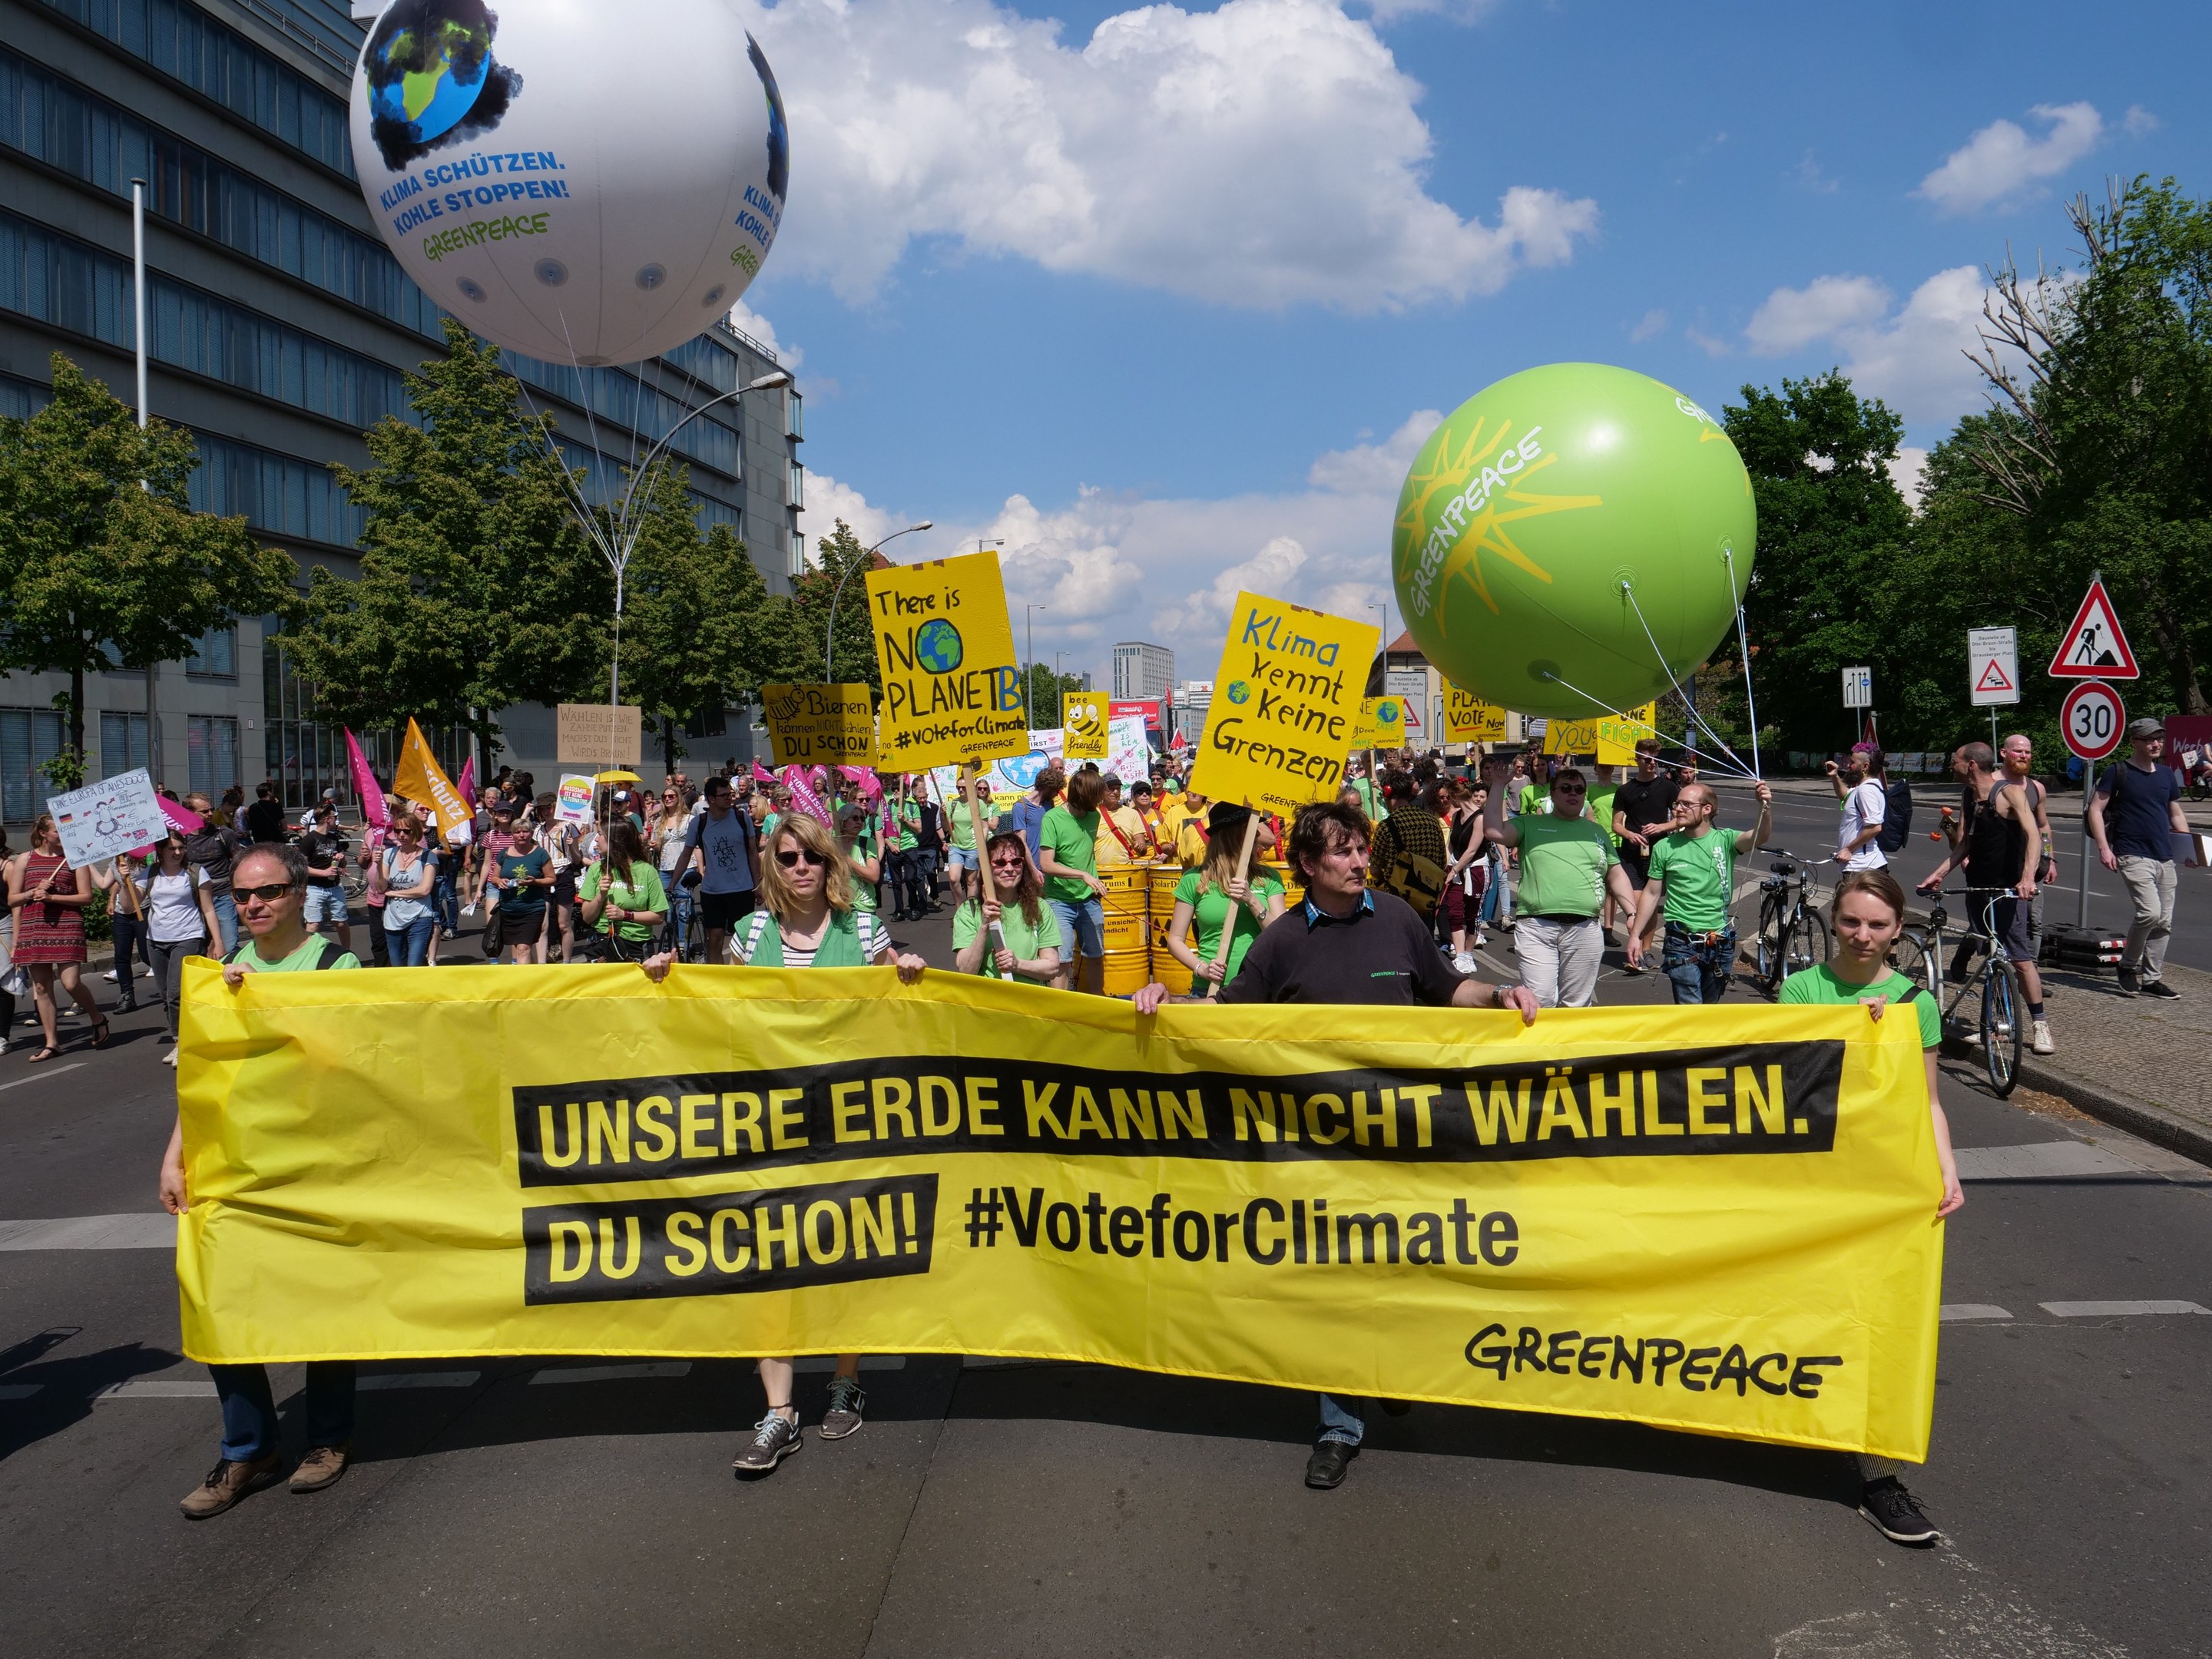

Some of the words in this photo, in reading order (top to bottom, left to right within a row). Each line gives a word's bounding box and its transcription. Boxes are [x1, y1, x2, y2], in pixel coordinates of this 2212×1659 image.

[379, 175, 423, 213] KLIMA
[423, 151, 566, 188] SCHÜTZEN.
[392, 198, 443, 237] KOHLE
[444, 180, 571, 213] STOPPEN!
[743, 184, 775, 221] KLIMA
[423, 212, 551, 263] GREENPEACE
[735, 210, 770, 247] KOHLE
[1410, 426, 1543, 618] GREENPEACE
[875, 590, 935, 615] There
[943, 586, 961, 610] is
[1242, 608, 1340, 667] Klima
[807, 690, 867, 715] Bienen
[887, 667, 1001, 724] PLANET
[1068, 694, 1088, 704] bee
[560, 707, 603, 723] WÄHLEN
[618, 714, 634, 724] WIE
[776, 720, 815, 735] können
[816, 719, 842, 733] NICHT
[840, 720, 872, 736] wählen
[1376, 721, 1396, 731] ERDE
[1621, 709, 1647, 722] ONE
[2075, 704, 2111, 738] 30
[562, 733, 593, 743] MACHST
[783, 735, 811, 757] DU
[816, 734, 869, 751] SCHON
[960, 738, 1016, 754] GREENPEACE
[1066, 736, 1103, 754] friendly
[1601, 722, 1653, 744] FIGHT
[1213, 717, 1341, 786] Grenzen
[69, 786, 97, 805] EUROPA
[125, 772, 148, 786] DOOF
[538, 1087, 809, 1168] UNSERE
[832, 1075, 1005, 1144] ERDE
[1022, 1079, 1209, 1141] KANN
[1229, 1082, 1442, 1148] NICHT
[1464, 1065, 1810, 1147] WÄHLEN.
[548, 1217, 642, 1283] DU
[664, 1191, 919, 1278] SCHON!
[964, 1187, 1521, 1267] #VoteforClimate
[1464, 1323, 1843, 1399] GREENPEACE
